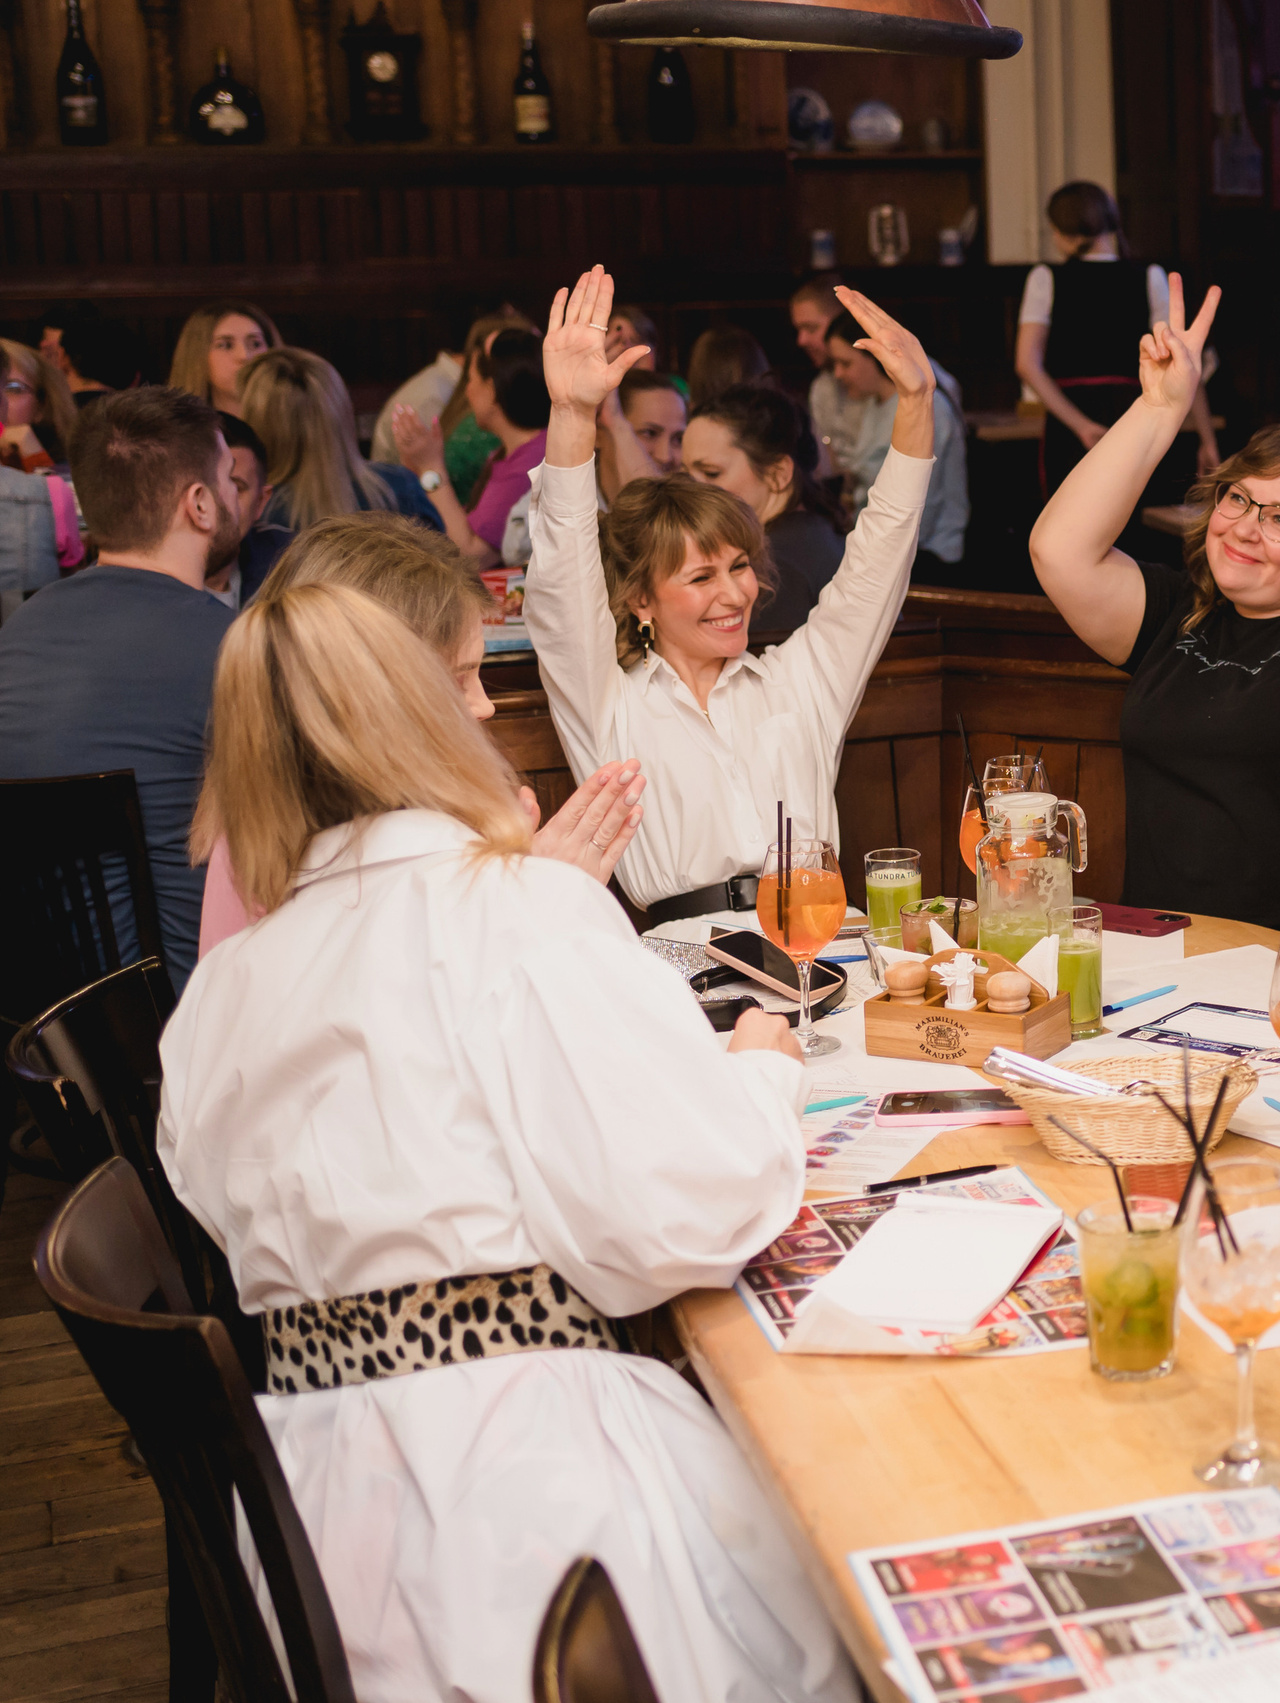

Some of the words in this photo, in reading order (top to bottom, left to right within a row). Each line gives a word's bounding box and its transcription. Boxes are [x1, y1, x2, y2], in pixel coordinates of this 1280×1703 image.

[874, 872, 906, 880] TUNDRA
[915, 1015, 970, 1037] MAXIMILIAN'S
[919, 1043, 968, 1060] BRAUEREI
